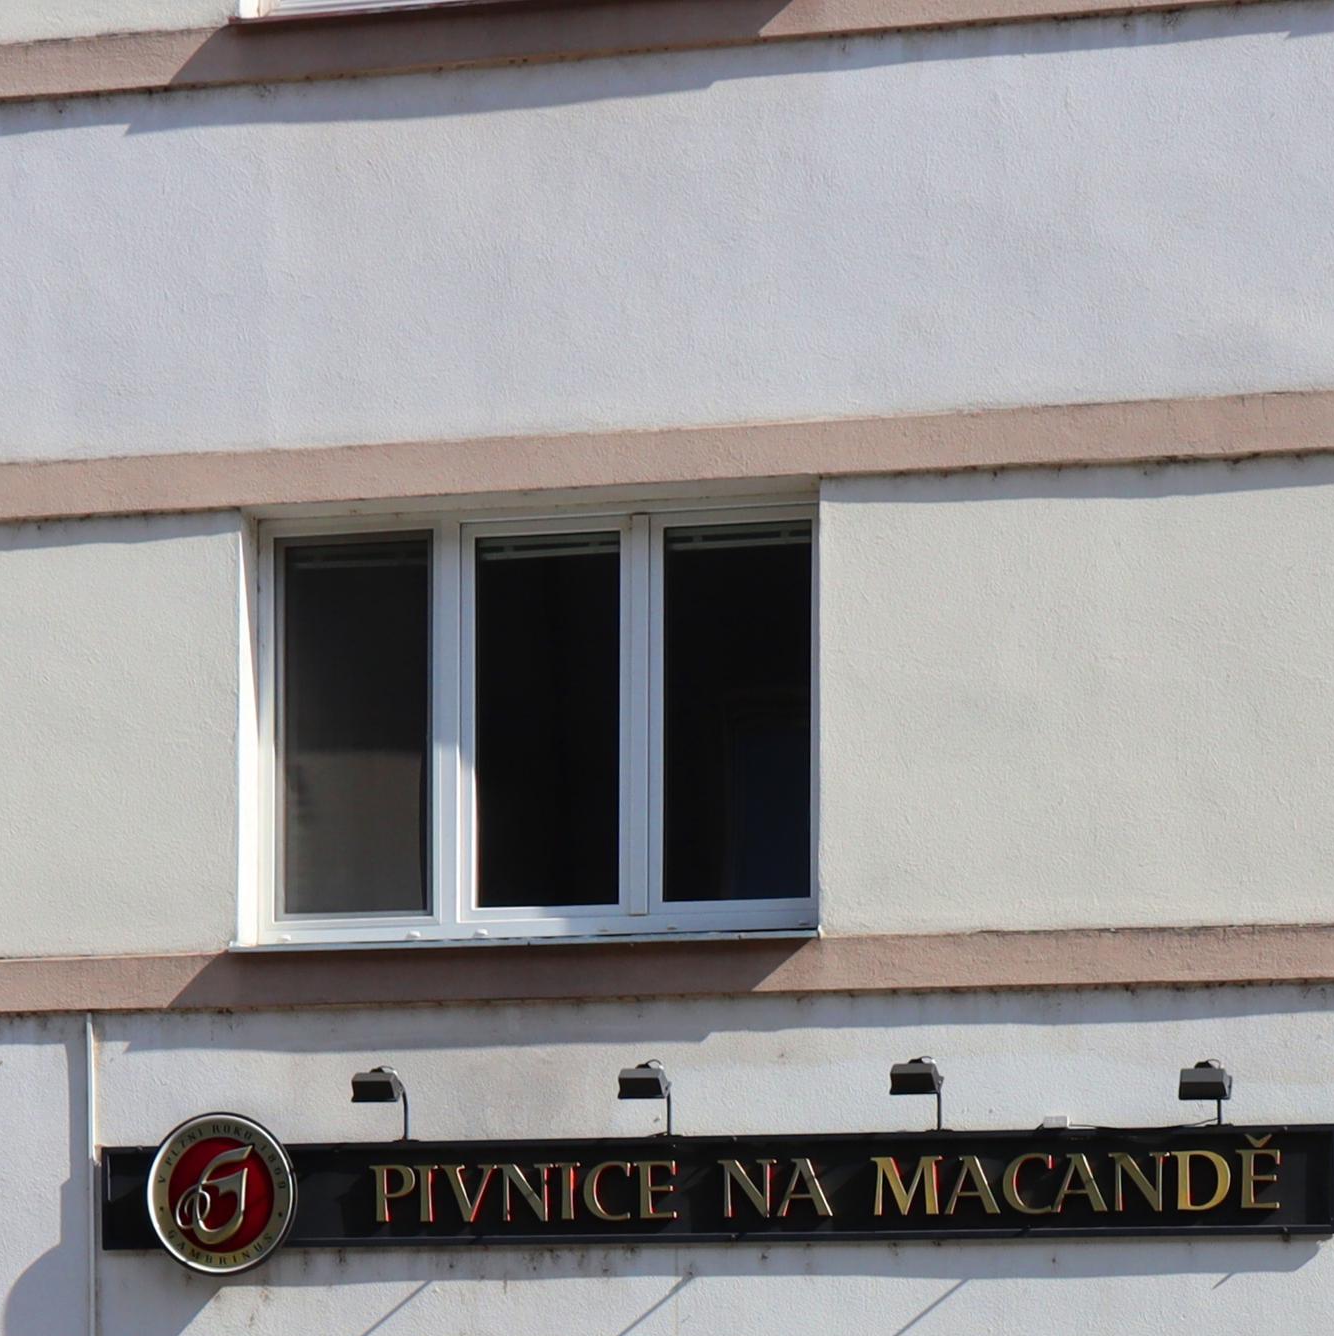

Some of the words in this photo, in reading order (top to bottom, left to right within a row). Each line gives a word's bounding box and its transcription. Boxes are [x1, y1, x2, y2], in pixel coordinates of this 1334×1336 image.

[369, 1160, 677, 1222] PIVNICE
[717, 1157, 833, 1220] NA
[870, 1135, 1283, 1217] MACANDĚ
